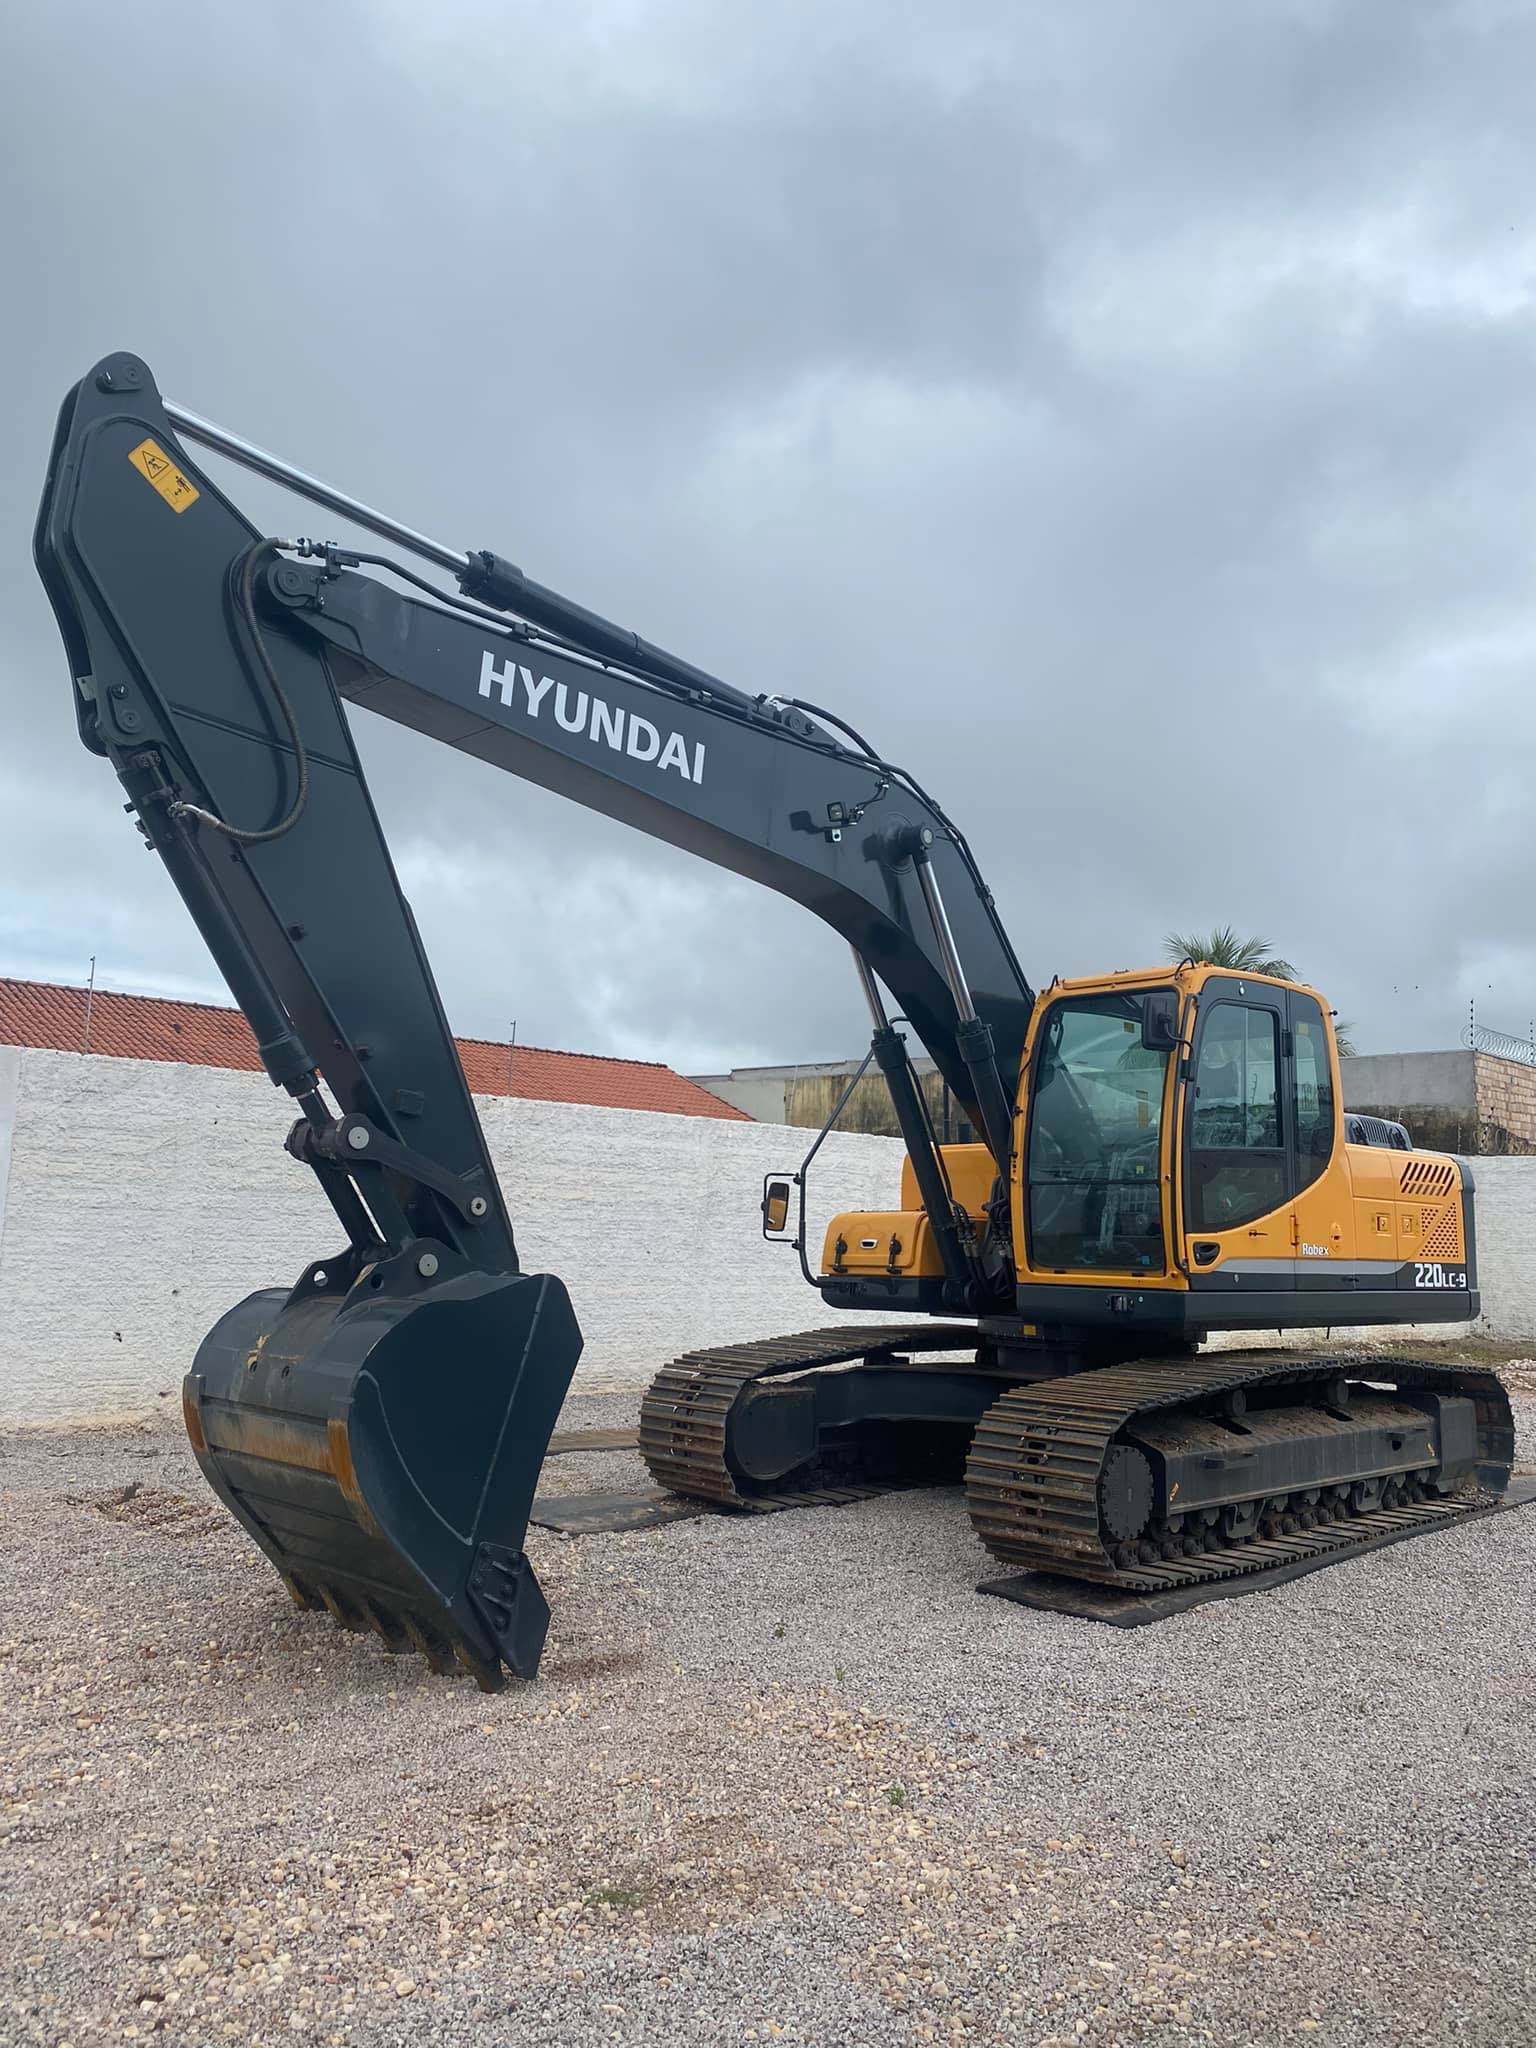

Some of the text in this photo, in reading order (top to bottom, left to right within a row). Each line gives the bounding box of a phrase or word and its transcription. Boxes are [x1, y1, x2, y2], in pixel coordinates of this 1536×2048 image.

[478, 650, 706, 784] HYUNDAI
[1302, 1243, 1329, 1256] Robex
[1414, 1263, 1467, 1288] 220LC-9
